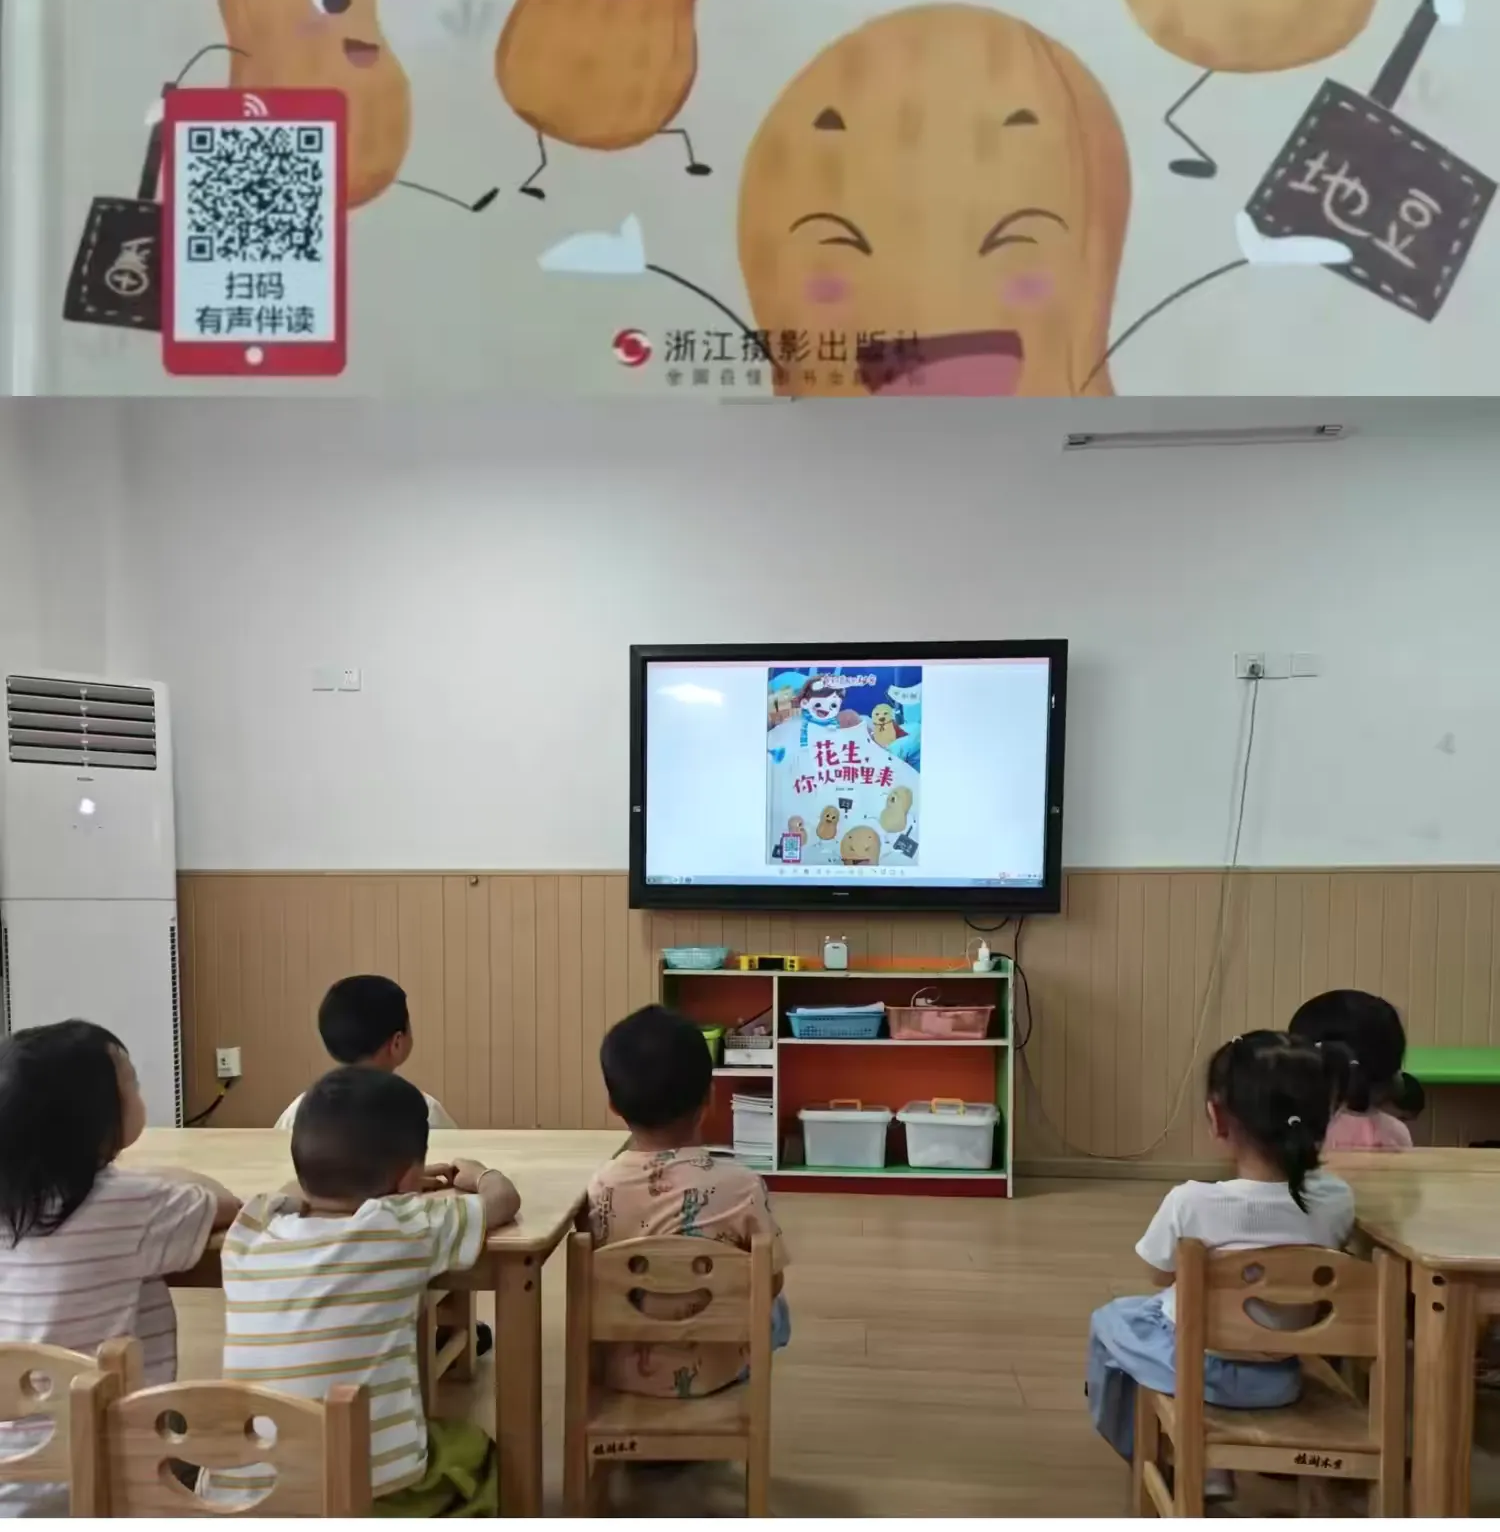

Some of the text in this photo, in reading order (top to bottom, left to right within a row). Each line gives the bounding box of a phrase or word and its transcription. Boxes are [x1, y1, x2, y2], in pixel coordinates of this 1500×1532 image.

[1287, 149, 1443, 270] 地豆
[224, 270, 285, 300] 扫码
[194, 304, 316, 335] 有声伴读
[793, 766, 895, 794] 你从哪里来
